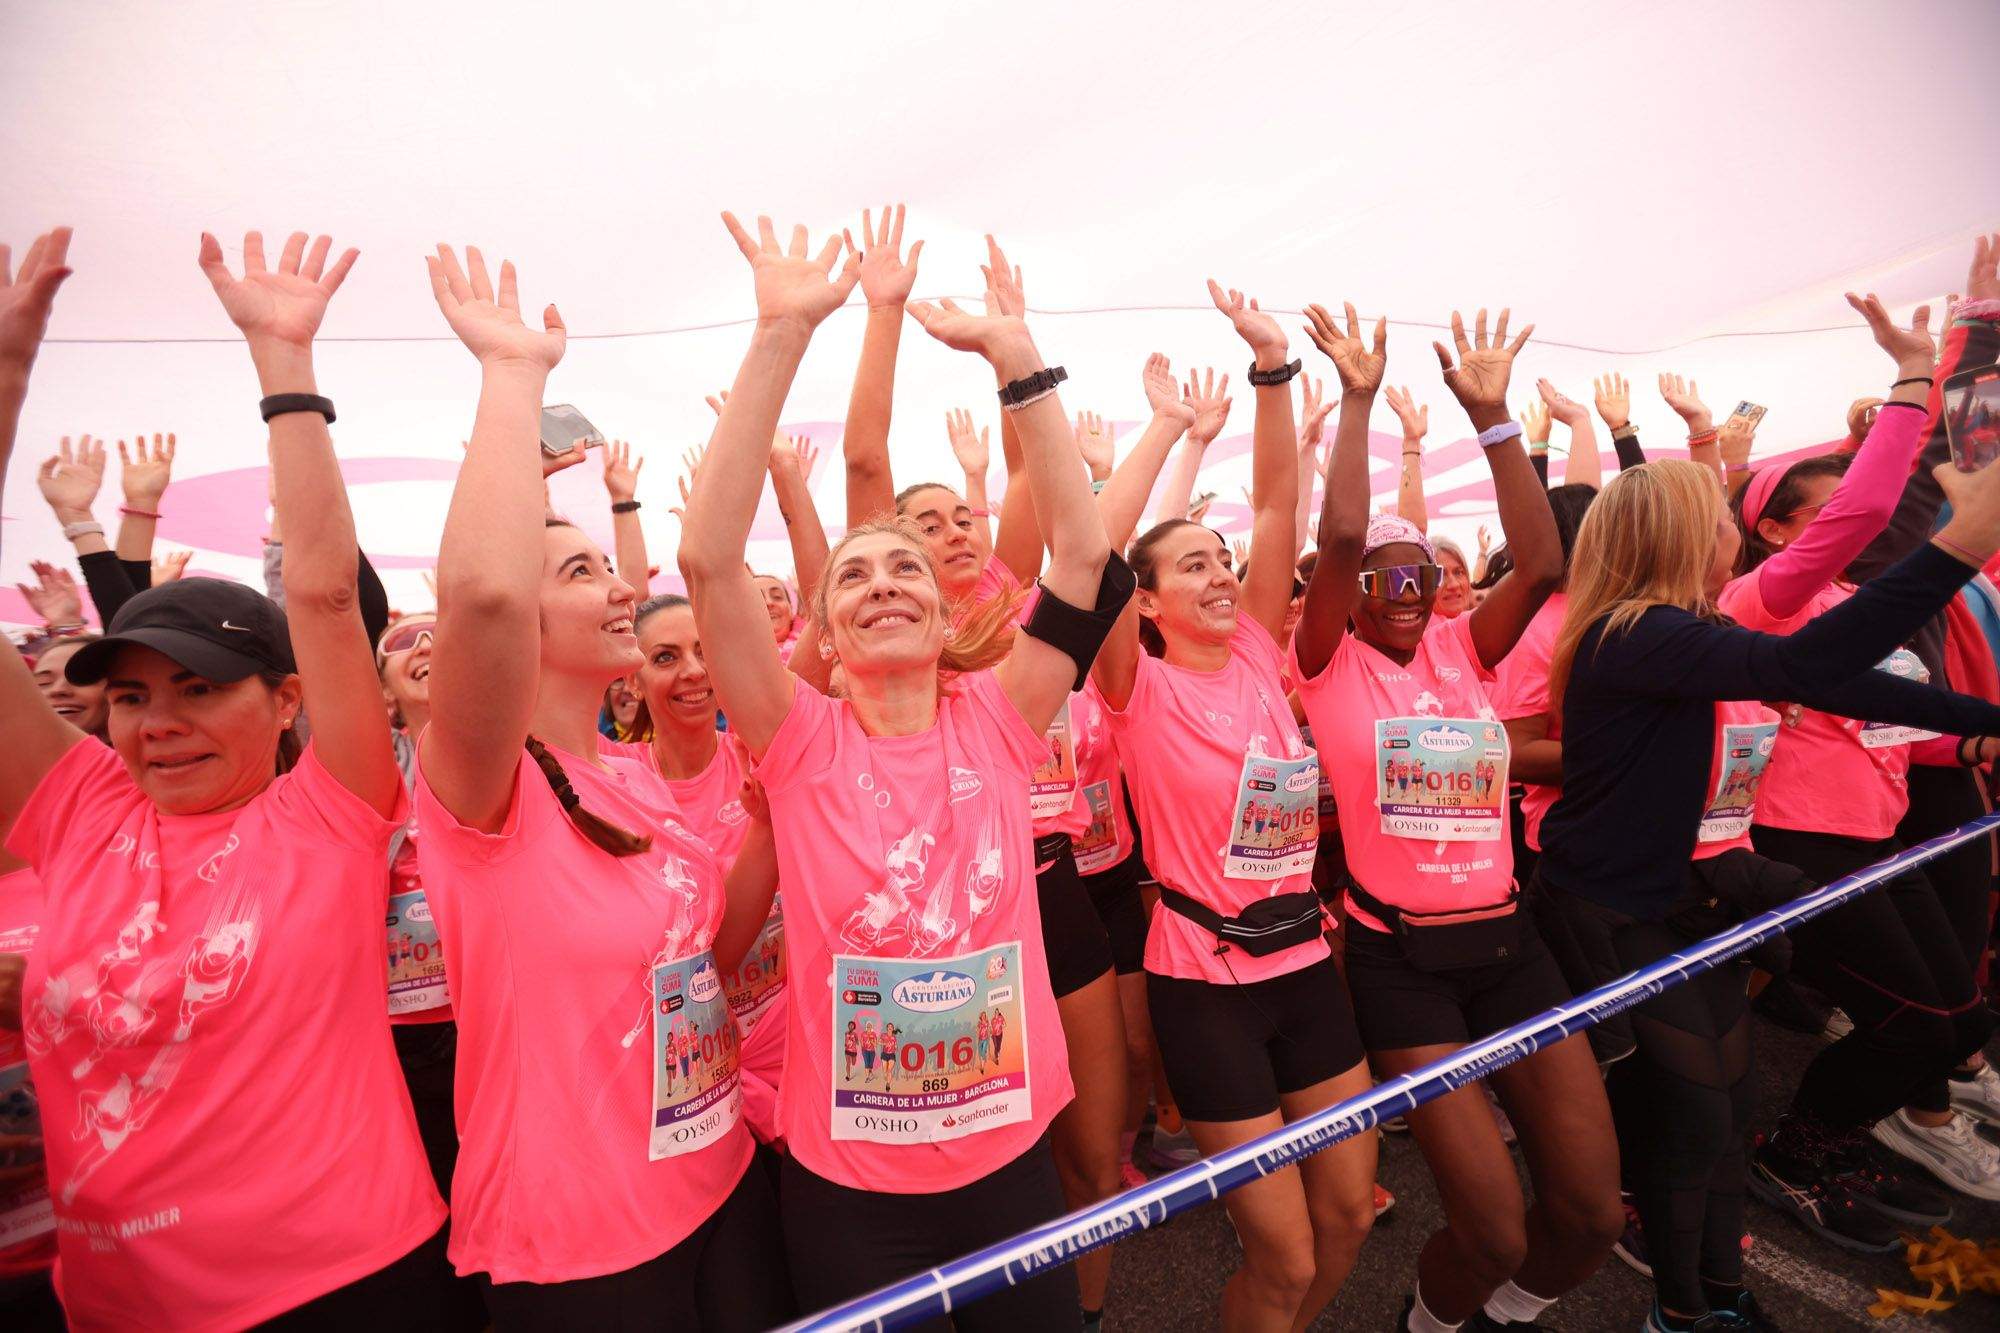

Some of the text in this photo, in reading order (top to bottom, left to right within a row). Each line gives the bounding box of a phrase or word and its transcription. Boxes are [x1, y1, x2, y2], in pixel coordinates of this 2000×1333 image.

[1422, 735, 1471, 748] ASTURIANA
[1252, 769, 1277, 780] SUMA
[1425, 771, 1472, 792] 016
[1039, 800, 1067, 810] Santander
[1435, 796, 1462, 806] 11329
[1392, 805, 1493, 816] CARRERA DE LA MUJER BARCELONA
[1280, 806, 1315, 833] 016
[1394, 820, 1492, 833] OYSHO Santander
[1710, 821, 1743, 833] OYSHO
[1283, 832, 1304, 846] 20627
[1243, 847, 1273, 858] CARRERA
[1273, 848, 1281, 857] DE
[1281, 846, 1288, 855] LA
[1288, 842, 1303, 853] MUJER
[1241, 862, 1282, 873] OYSHO
[1416, 858, 1494, 874] CARRERA DE LA MUJER
[1450, 873, 1468, 884] 2024
[661, 981, 682, 995] SUMA
[847, 974, 880, 987] SUMA
[898, 985, 973, 1004] ASTURIANA
[701, 1023, 731, 1064] 016
[900, 1036, 974, 1072] 016
[853, 1077, 1010, 1108] CARRERA DE LA MUJER BARCELONA
[922, 1077, 949, 1093] 869
[674, 1097, 705, 1118] CARRERA
[705, 1092, 713, 1104] DE
[712, 1088, 719, 1099] LA
[855, 1102, 1010, 1133] OYSHO Santander
[675, 1111, 721, 1143] OYSHO
[121, 1206, 181, 1240] MUJER
